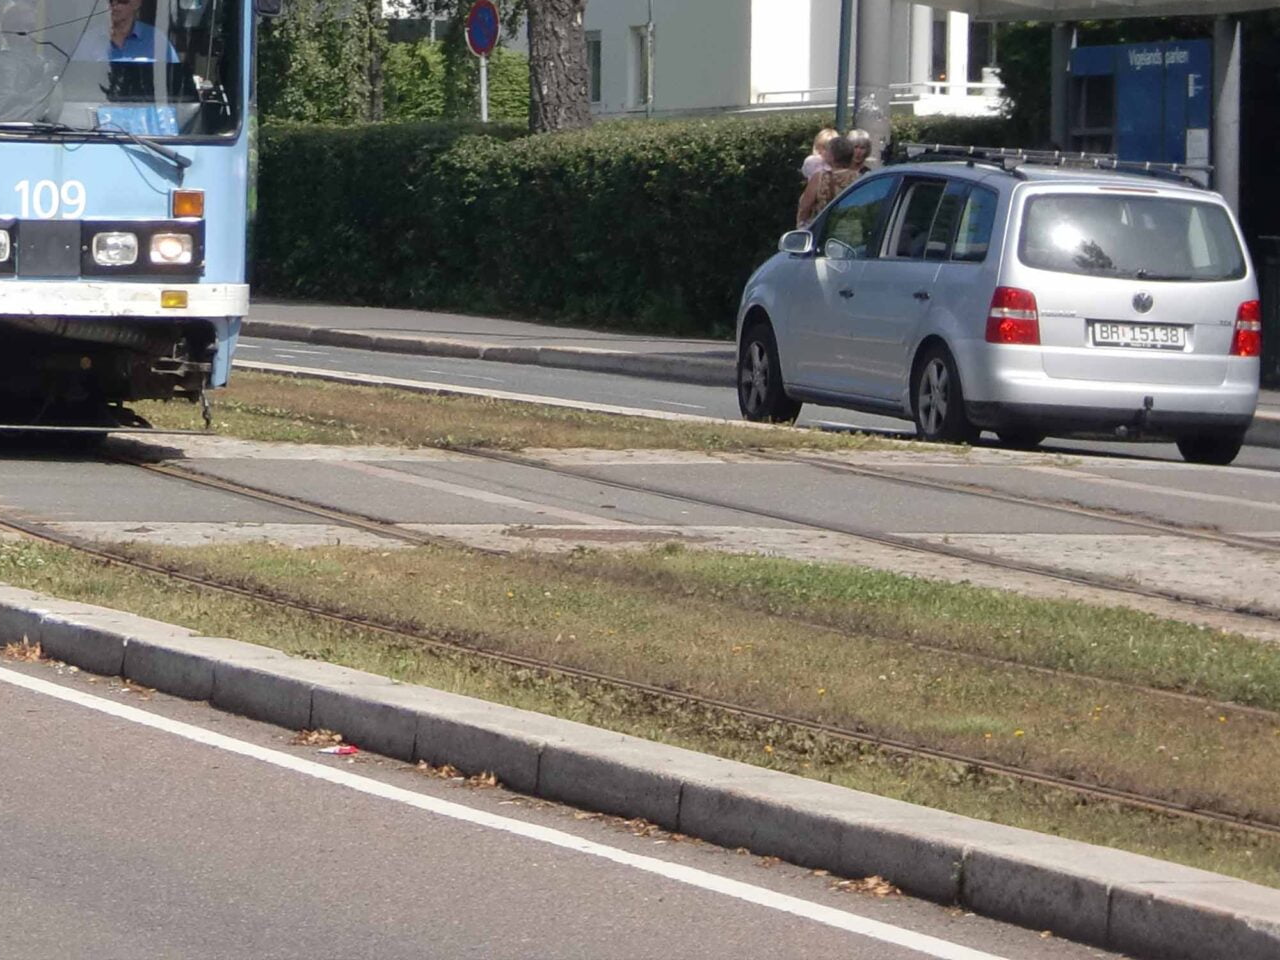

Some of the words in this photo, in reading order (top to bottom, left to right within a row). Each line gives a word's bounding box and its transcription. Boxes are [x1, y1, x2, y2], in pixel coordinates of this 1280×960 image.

[14, 179, 87, 220] 109
[1100, 325, 1120, 340] BR
[1130, 326, 1179, 343] 15138
